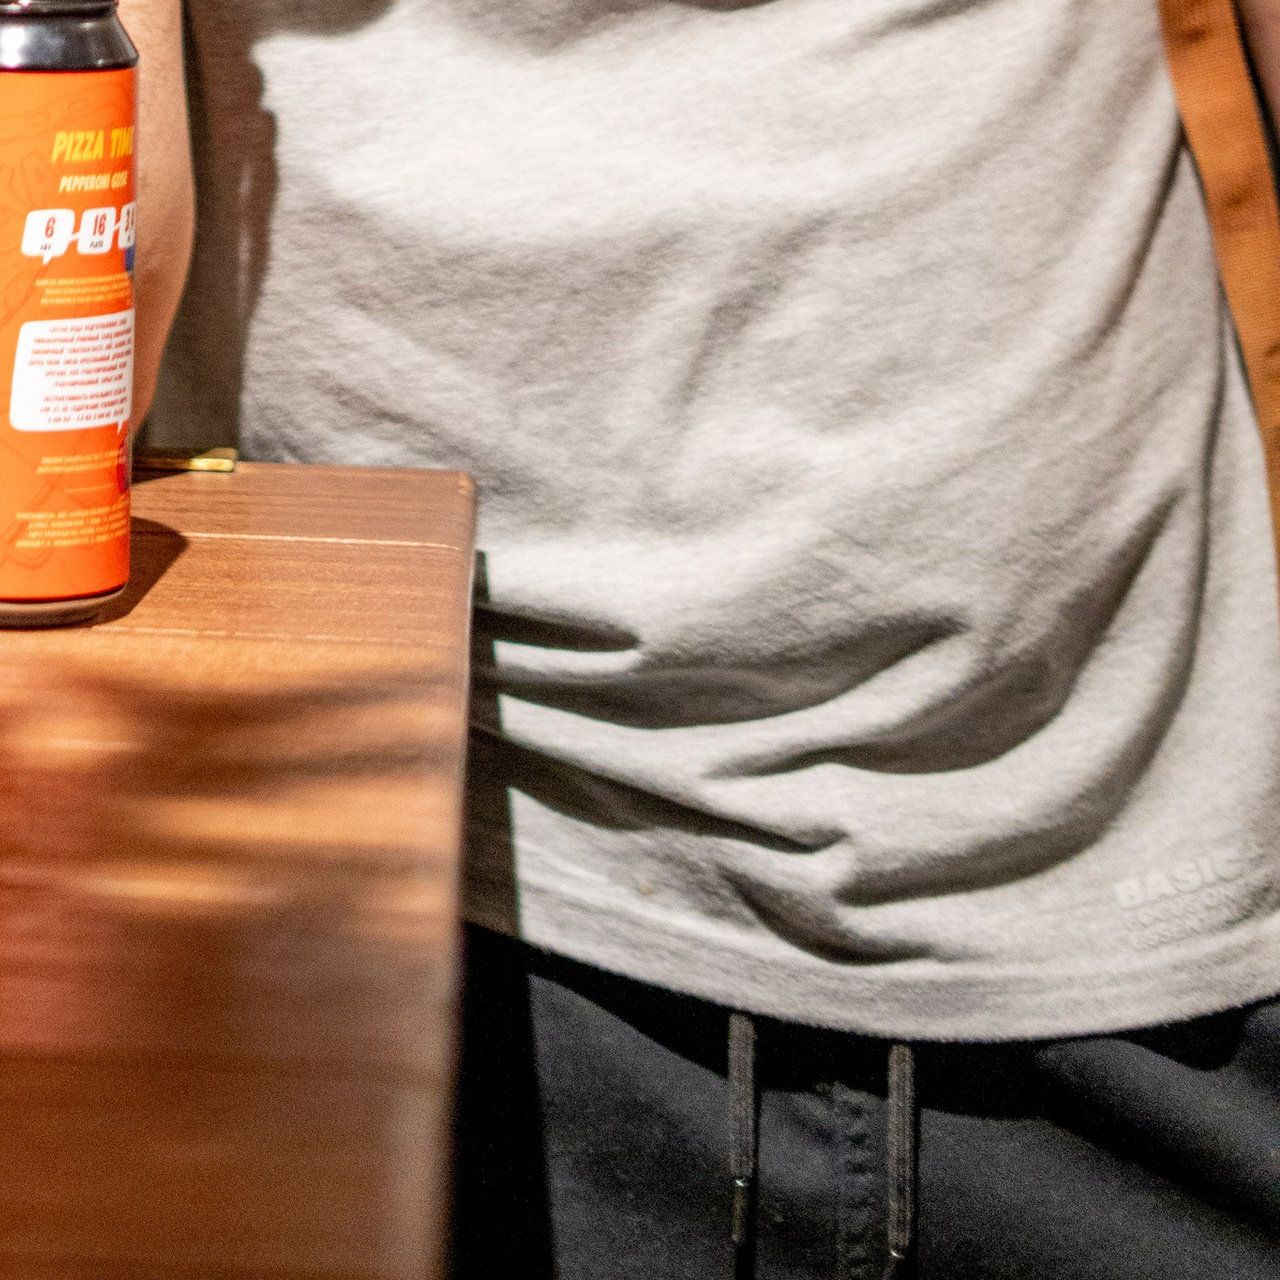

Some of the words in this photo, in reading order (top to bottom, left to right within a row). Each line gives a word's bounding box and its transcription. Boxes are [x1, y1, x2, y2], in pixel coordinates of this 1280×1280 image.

[51, 130, 104, 162] PIZZA
[59, 172, 110, 192] PEPPERONI
[45, 216, 56, 238] 6
[92, 213, 107, 236] 16
[1114, 848, 1245, 910] BASIC
